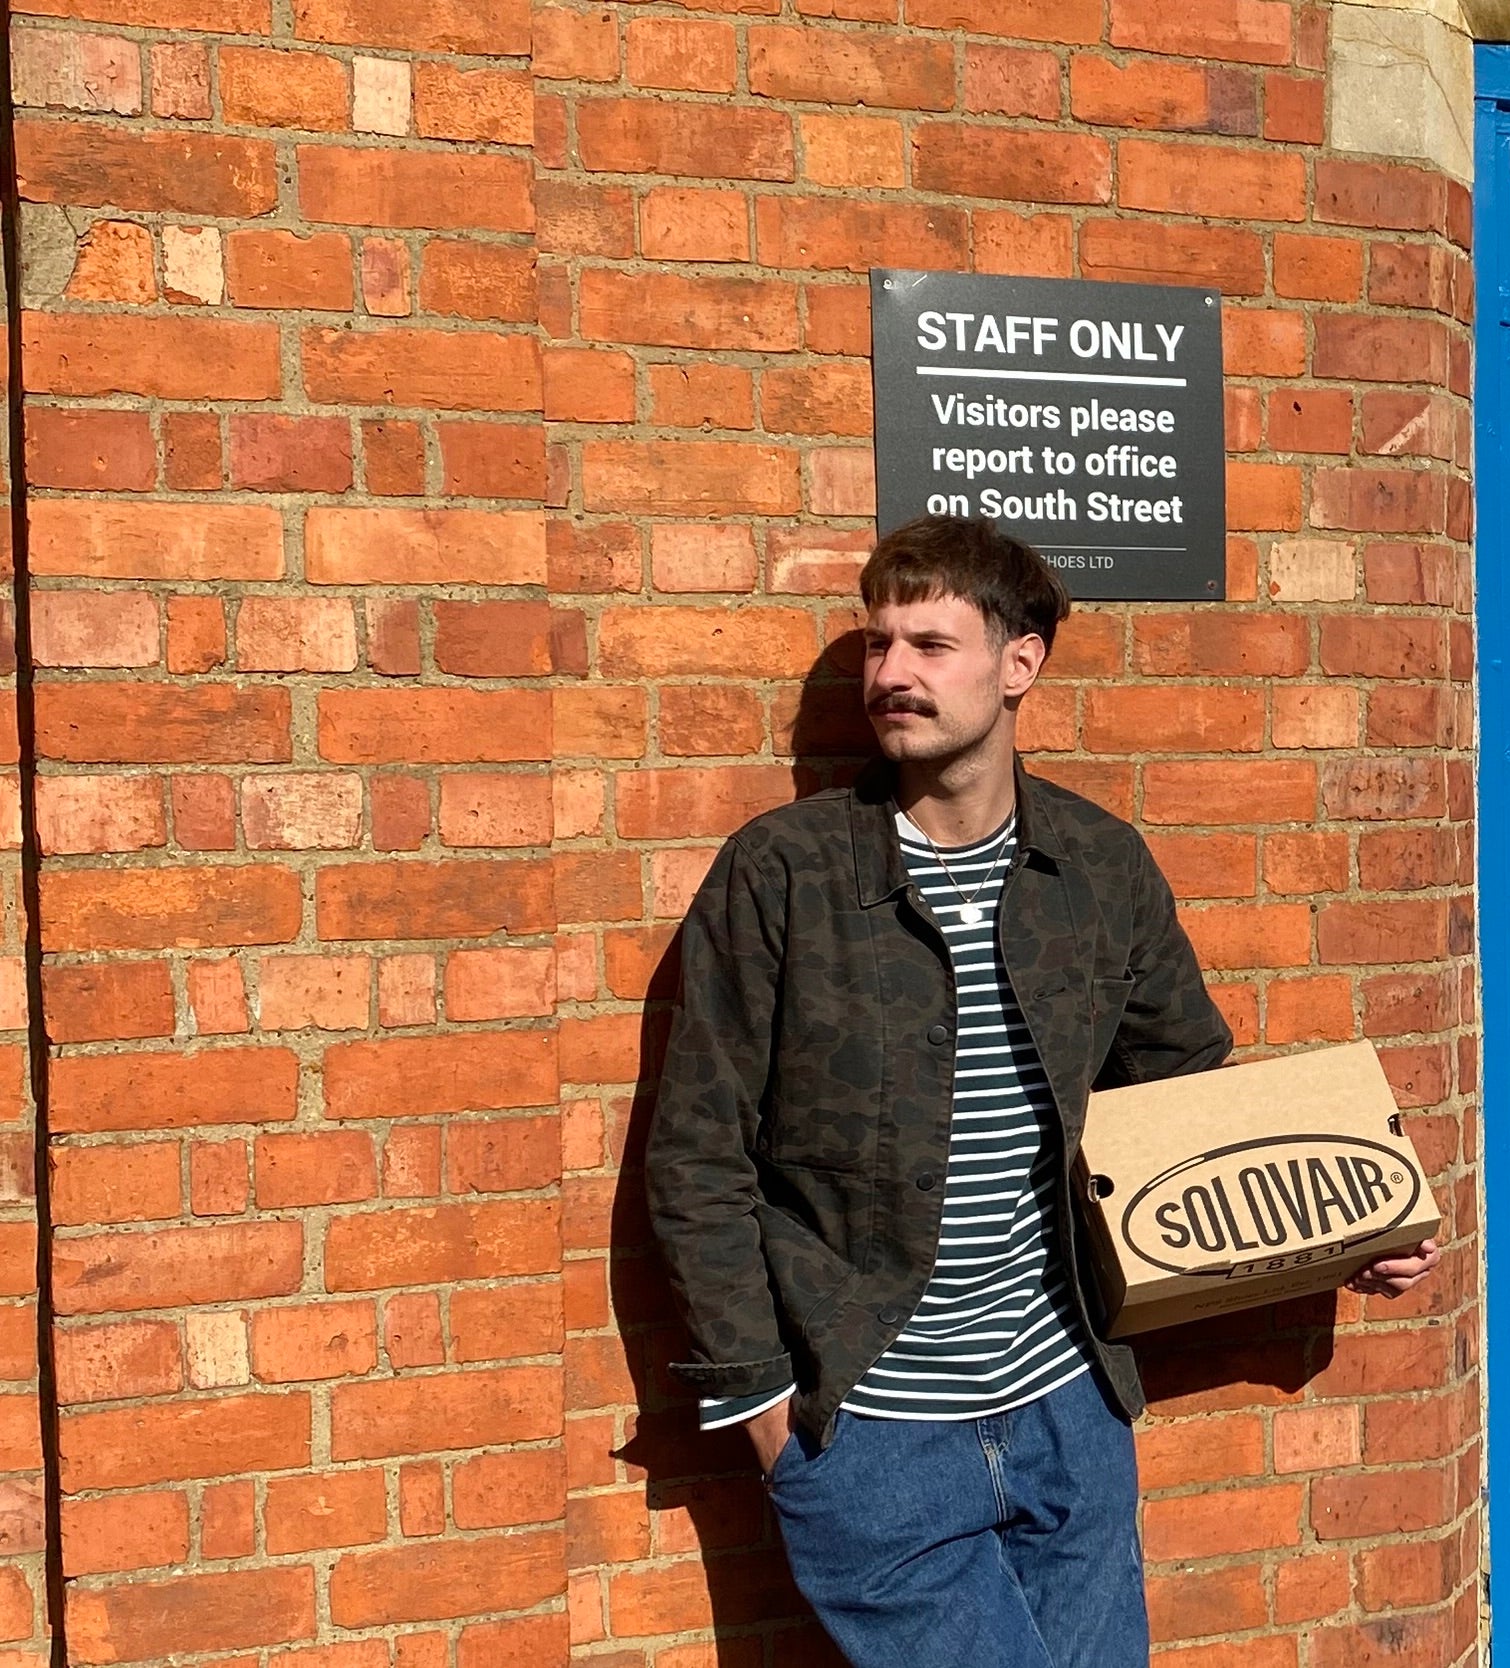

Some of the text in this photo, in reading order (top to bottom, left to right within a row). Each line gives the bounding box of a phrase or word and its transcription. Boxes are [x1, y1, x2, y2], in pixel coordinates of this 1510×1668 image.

[918, 311, 1184, 361] STAFF ONLY
[931, 393, 1174, 436] Visitors please
[933, 445, 1176, 479] report to office
[927, 489, 1182, 523] on South Street
[1090, 556, 1113, 568] LTD
[1242, 1246, 1335, 1273] 1881
